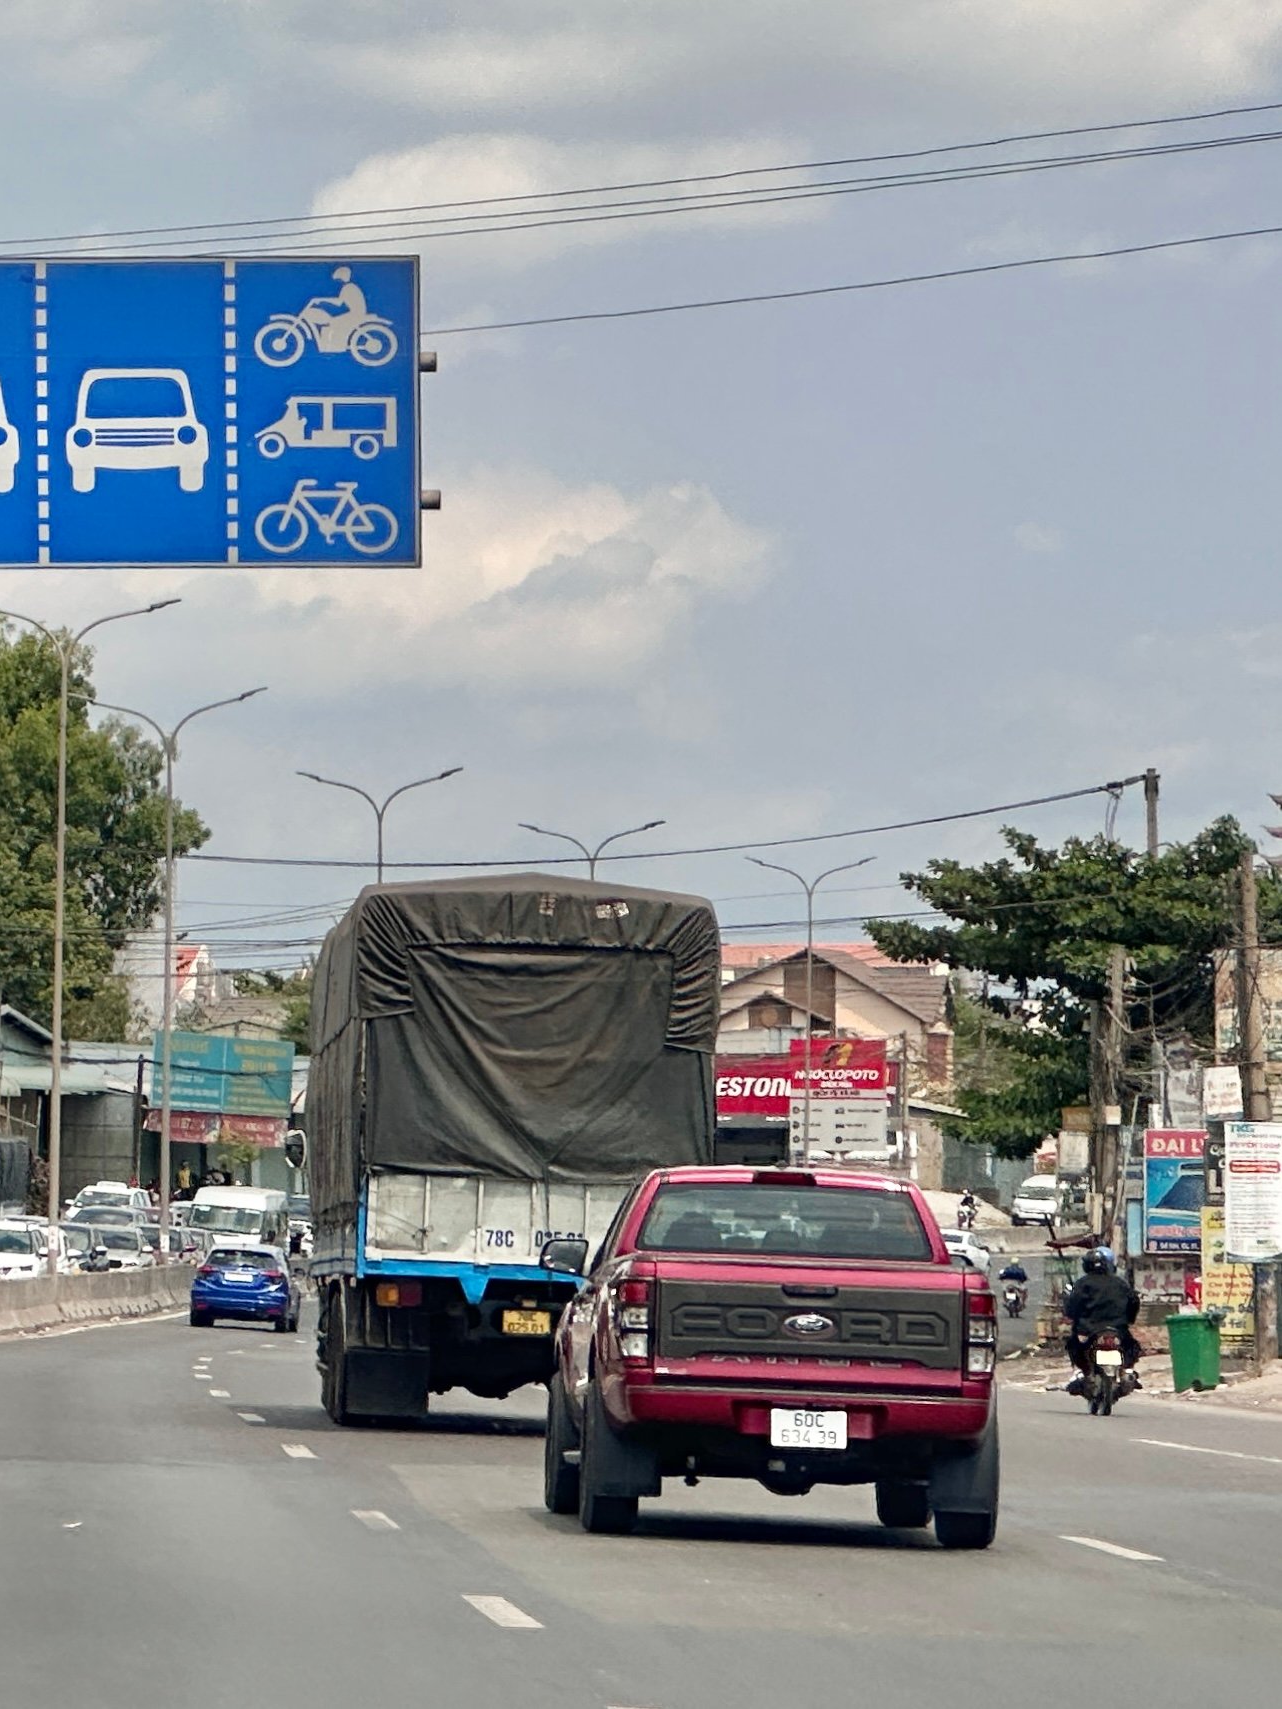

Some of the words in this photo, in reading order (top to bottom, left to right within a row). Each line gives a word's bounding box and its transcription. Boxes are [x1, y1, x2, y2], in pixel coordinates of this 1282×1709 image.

[716, 1077, 791, 1097] ESTON
[1151, 1138, 1185, 1157] ĐẠI
[486, 1230, 514, 1248] 78C
[670, 1303, 950, 1346] FORD
[794, 1413, 825, 1428] 60C
